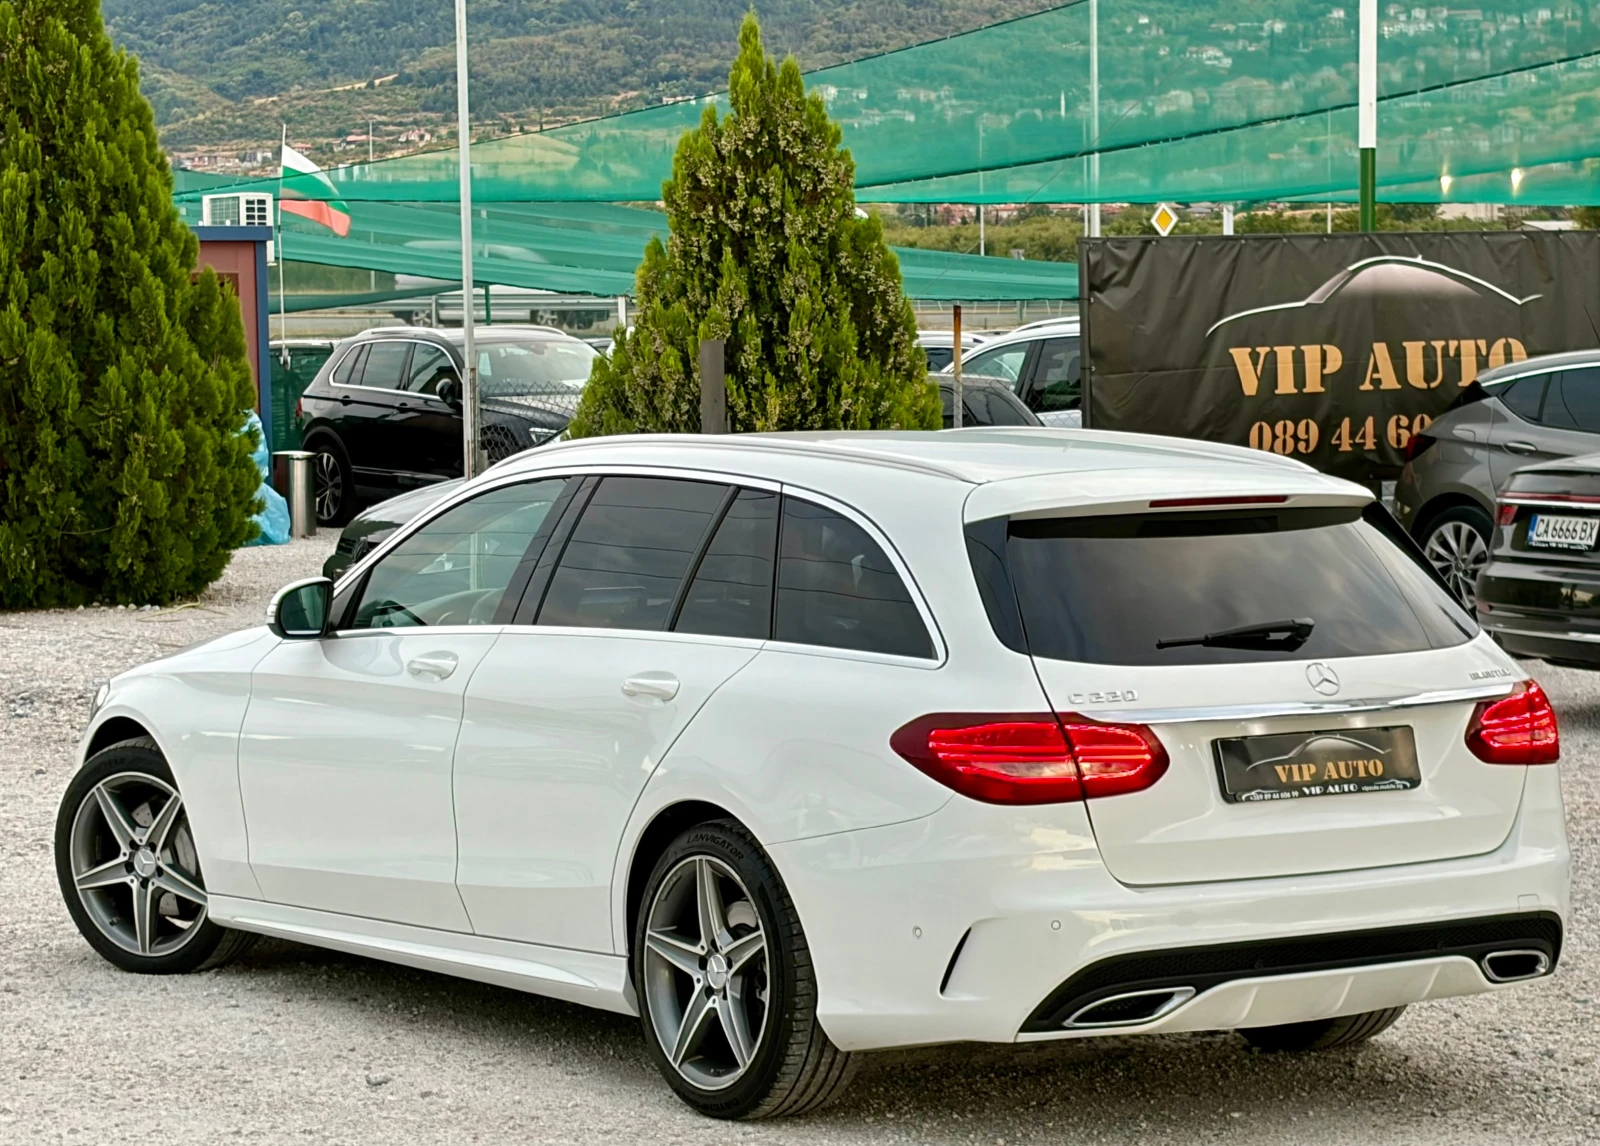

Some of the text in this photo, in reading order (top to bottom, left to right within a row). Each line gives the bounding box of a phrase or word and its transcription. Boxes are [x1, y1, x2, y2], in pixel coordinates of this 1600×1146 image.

[1228, 337, 1529, 396] VIP AUTO
[1249, 418, 1319, 454] 089
[1331, 416, 1377, 451] 44
[1551, 519, 1579, 540] 6666
[1068, 689, 1139, 704] C 220
[1274, 759, 1384, 783] VIP AUTO
[1302, 786, 1324, 795] VIP
[1326, 783, 1358, 793] AUTO
[686, 833, 745, 861] LANVIGATOR
